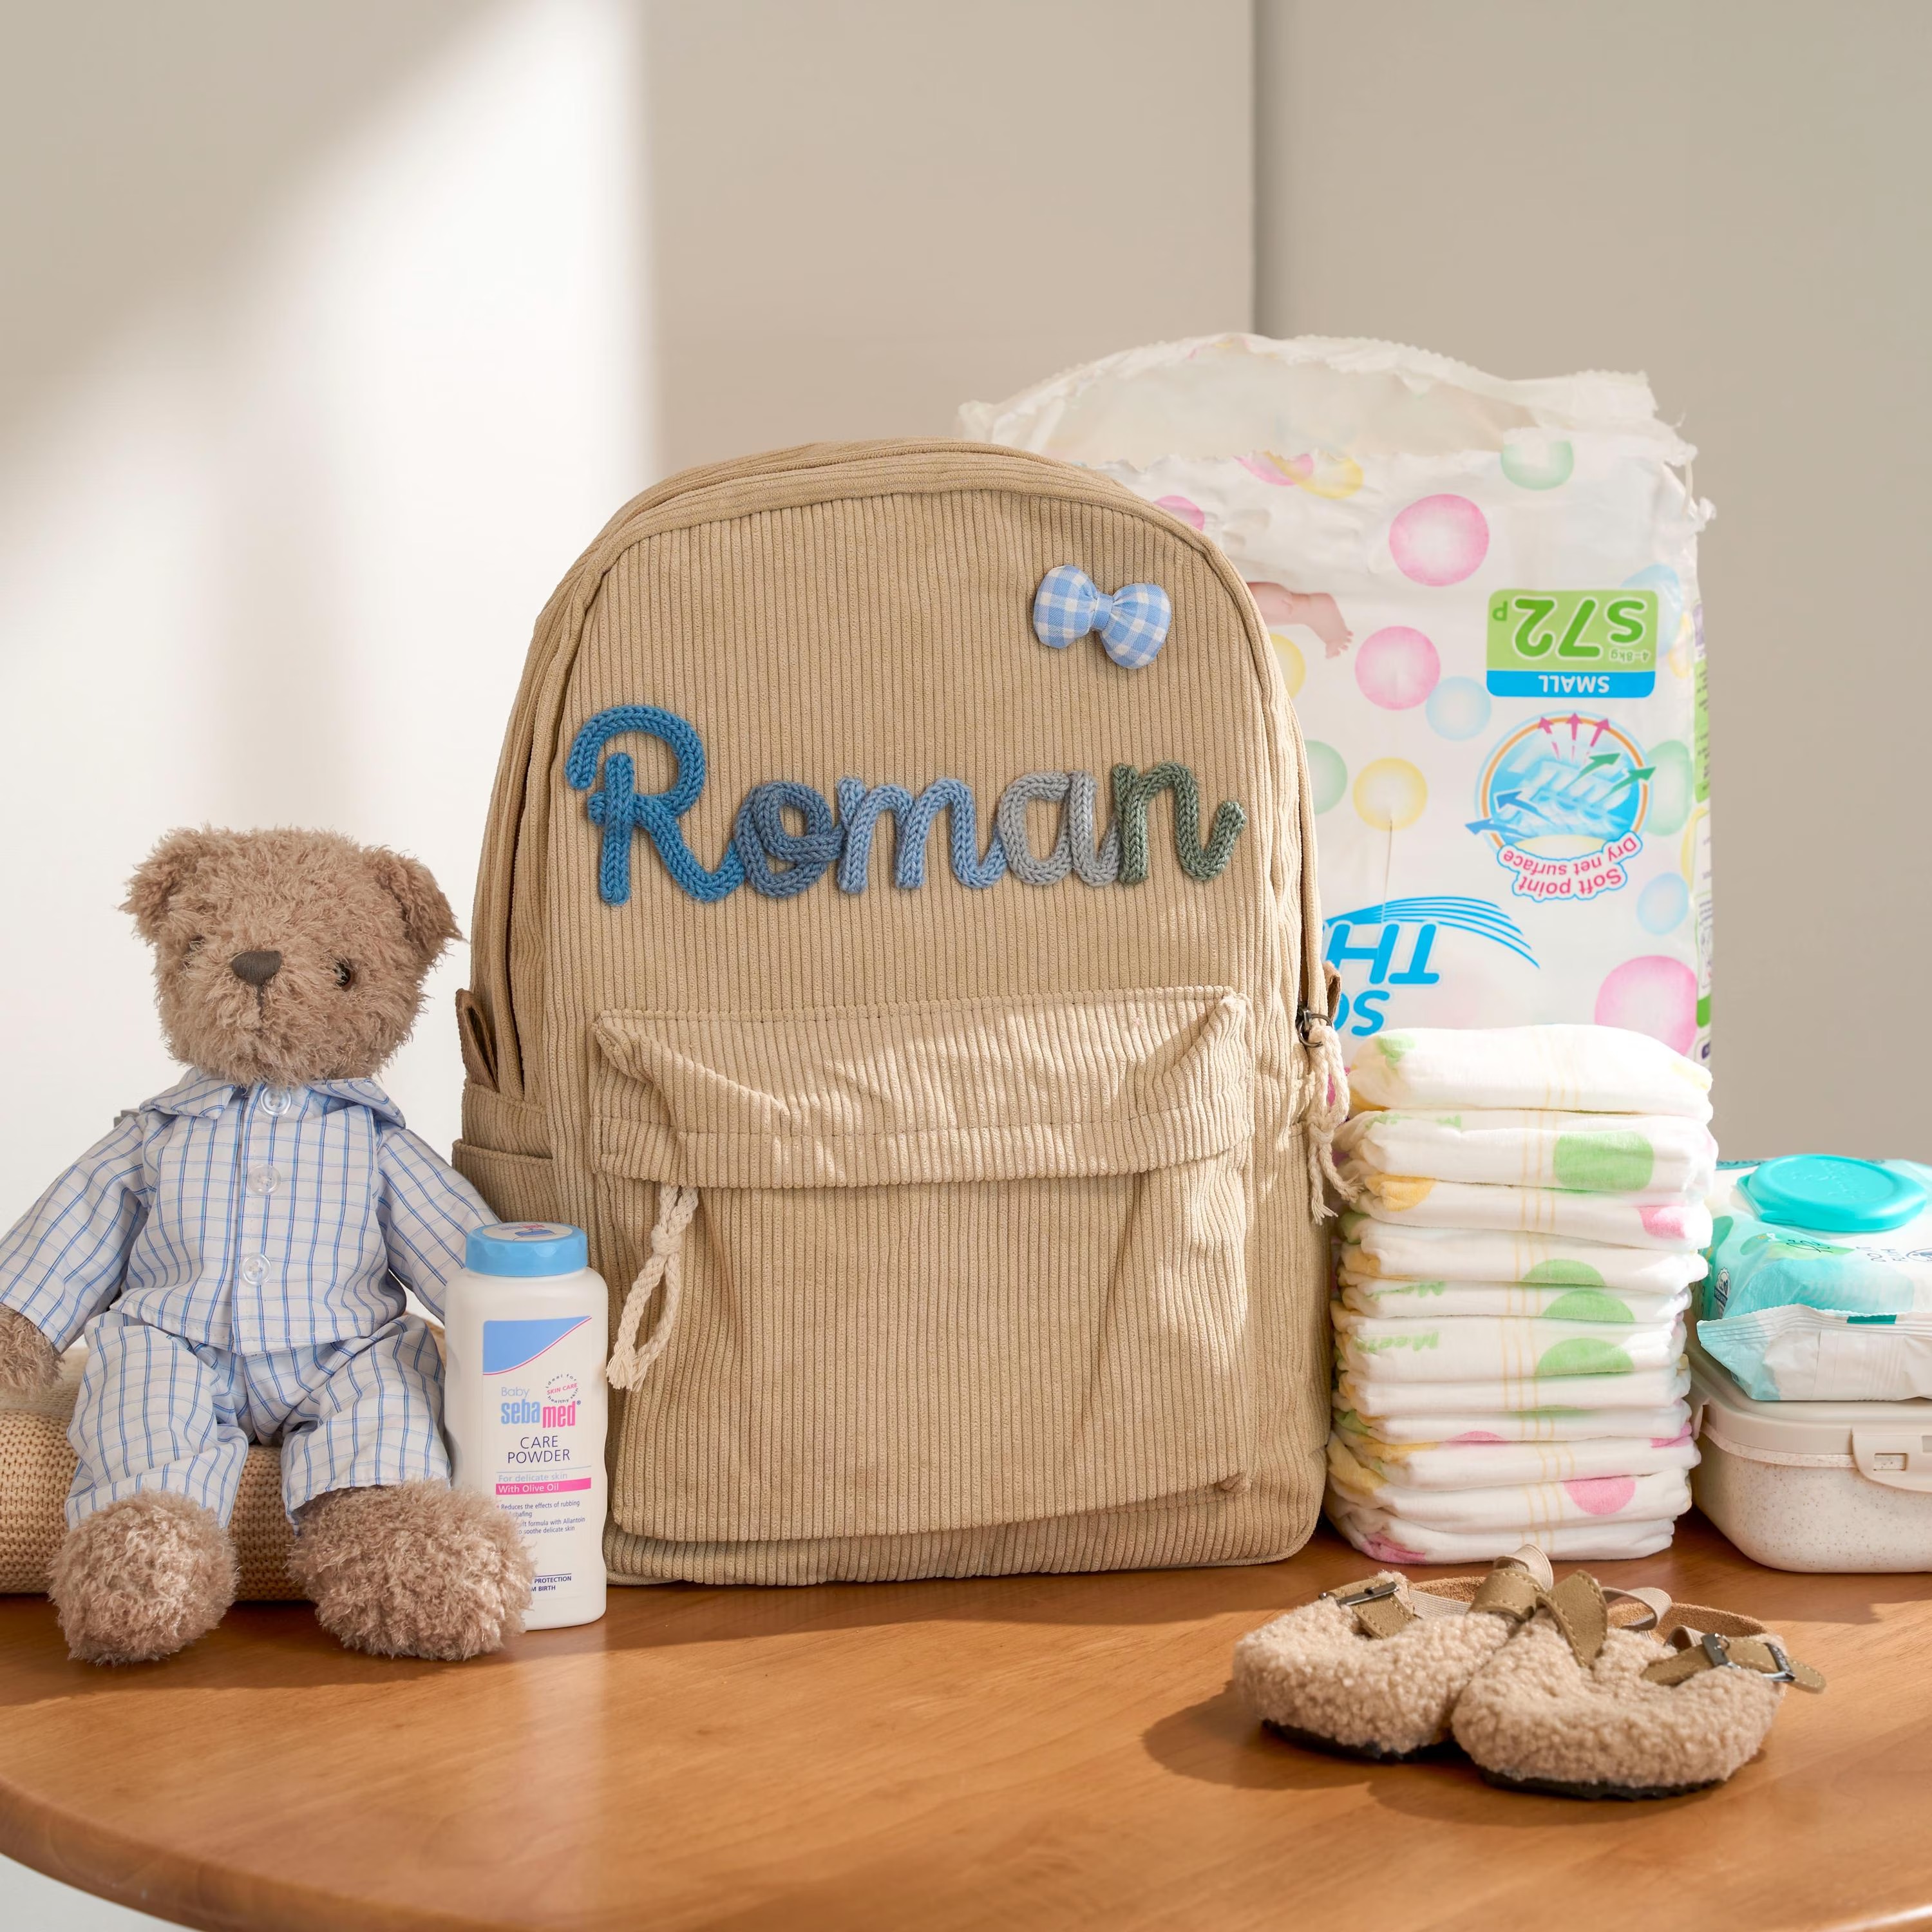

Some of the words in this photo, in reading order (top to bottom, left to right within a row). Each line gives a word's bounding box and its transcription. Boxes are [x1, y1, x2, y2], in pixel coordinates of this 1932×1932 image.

[1492, 601, 1508, 621] P
[1538, 675, 1610, 694] SMALL
[565, 704, 1247, 905] Roman
[1608, 837, 1637, 862] Dry
[1503, 850, 1567, 876] surface
[1573, 857, 1602, 876] net
[1519, 876, 1571, 897] point
[1578, 869, 1622, 895] Soft
[1322, 923, 1439, 985] TH
[501, 1387, 530, 1398] Baby
[562, 1383, 578, 1391] CARE
[520, 1435, 558, 1449] CARE
[507, 1449, 571, 1463] POWDER
[498, 1485, 520, 1493] With
[522, 1484, 544, 1492] Olive
